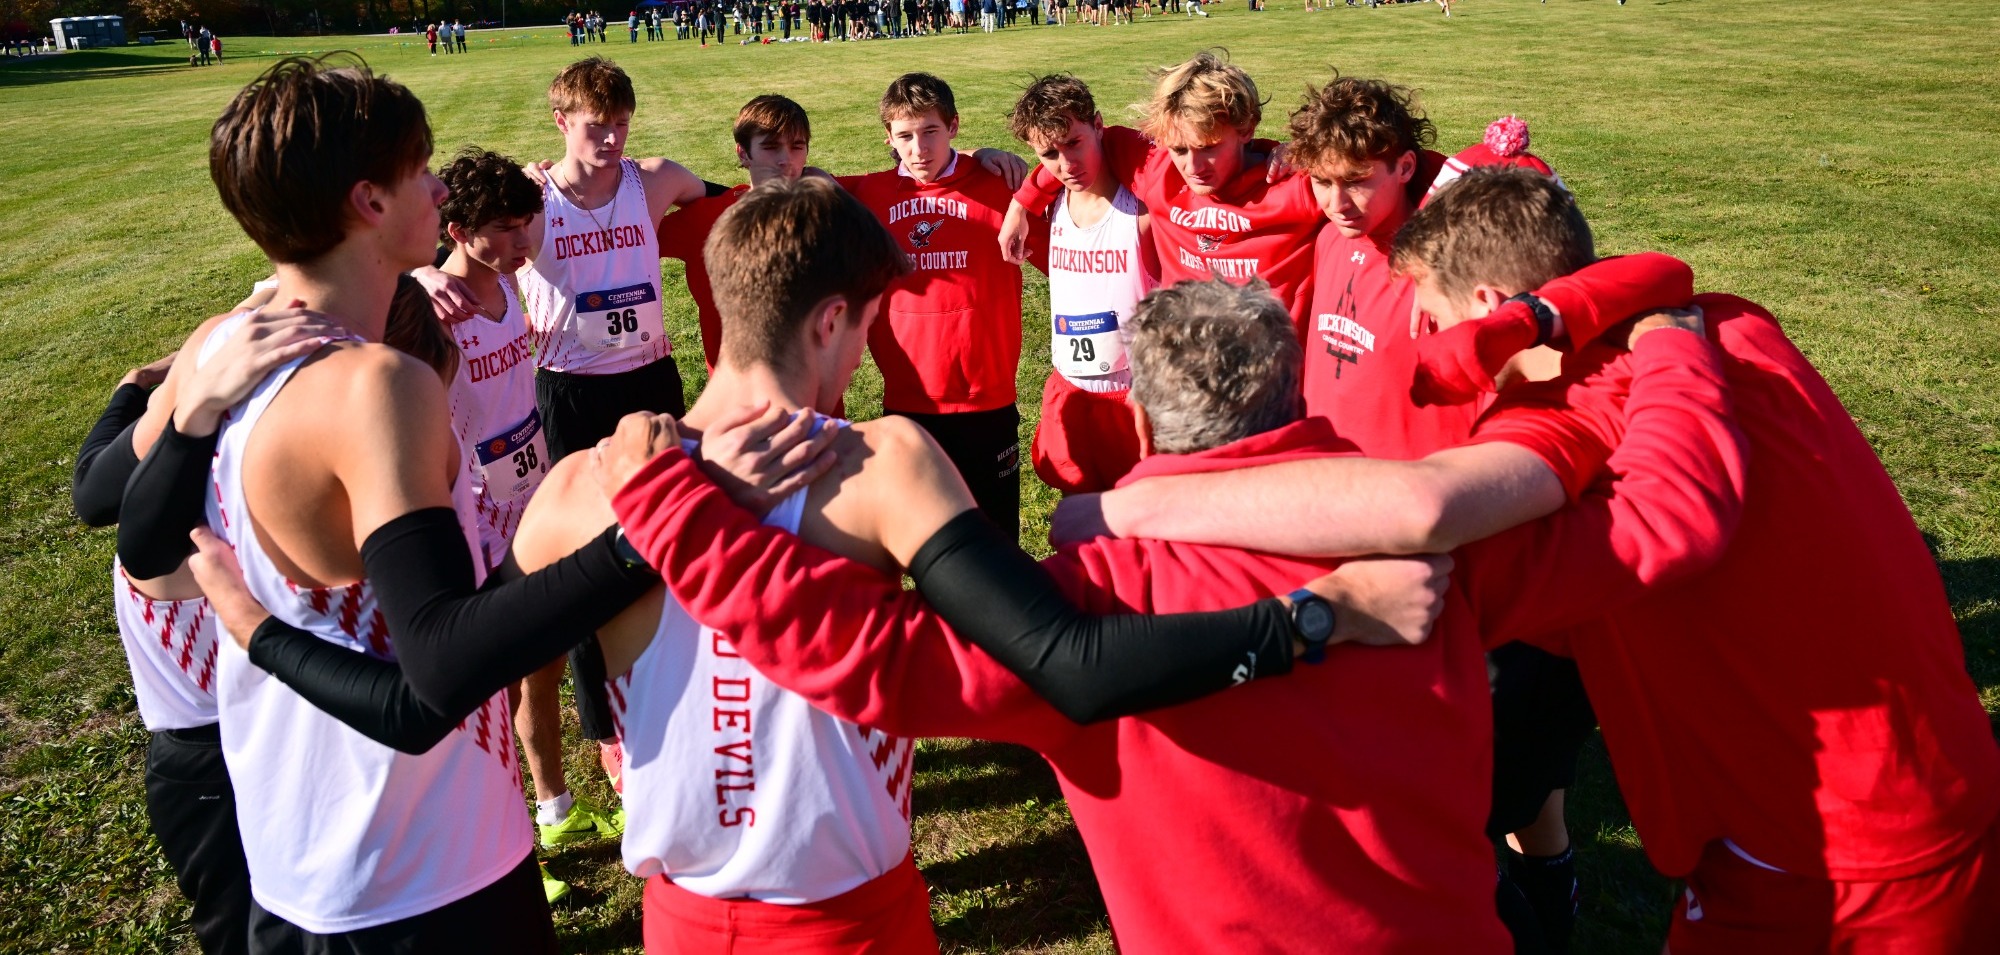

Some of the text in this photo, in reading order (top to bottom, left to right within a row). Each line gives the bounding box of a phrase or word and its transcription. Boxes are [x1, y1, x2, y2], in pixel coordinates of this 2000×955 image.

[889, 196, 968, 225] DICKINSON
[554, 224, 646, 260] DICKINSON
[920, 250, 968, 270] COUNTRY
[1051, 246, 1128, 274] DICKINSON
[608, 288, 647, 301] CENTENNIAL
[606, 308, 638, 336] 36
[1317, 313, 1376, 353] DICKINSON
[1069, 337, 1096, 362] 29
[512, 443, 538, 479] 38
[712, 676, 756, 828] DEVILS
